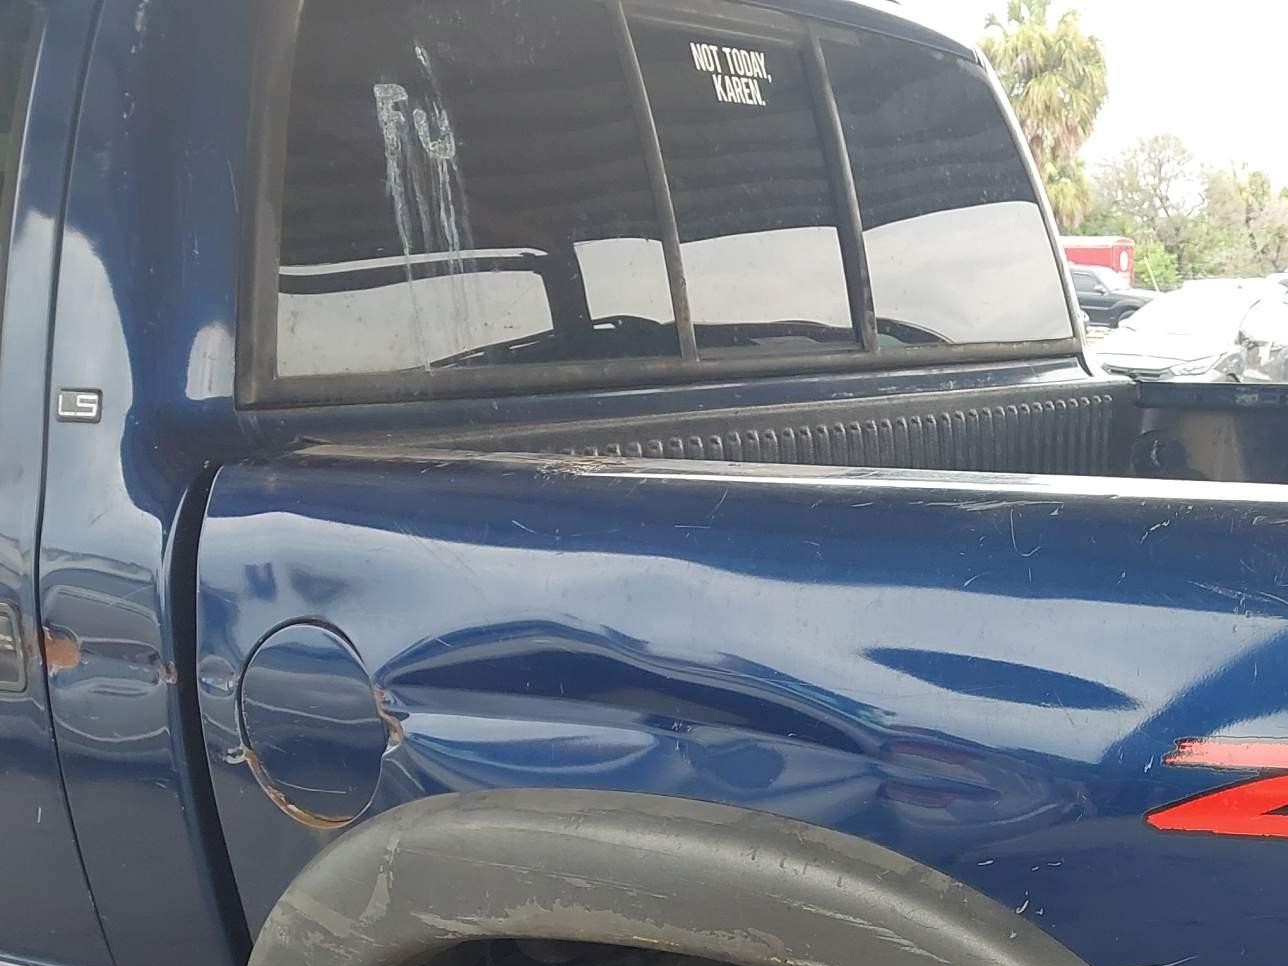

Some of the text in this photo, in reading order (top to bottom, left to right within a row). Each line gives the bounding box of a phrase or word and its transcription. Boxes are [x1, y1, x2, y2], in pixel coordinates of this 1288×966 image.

[690, 42, 773, 84] NOT TODAY,
[712, 73, 767, 106] KAREN.
[58, 393, 99, 417] LS
